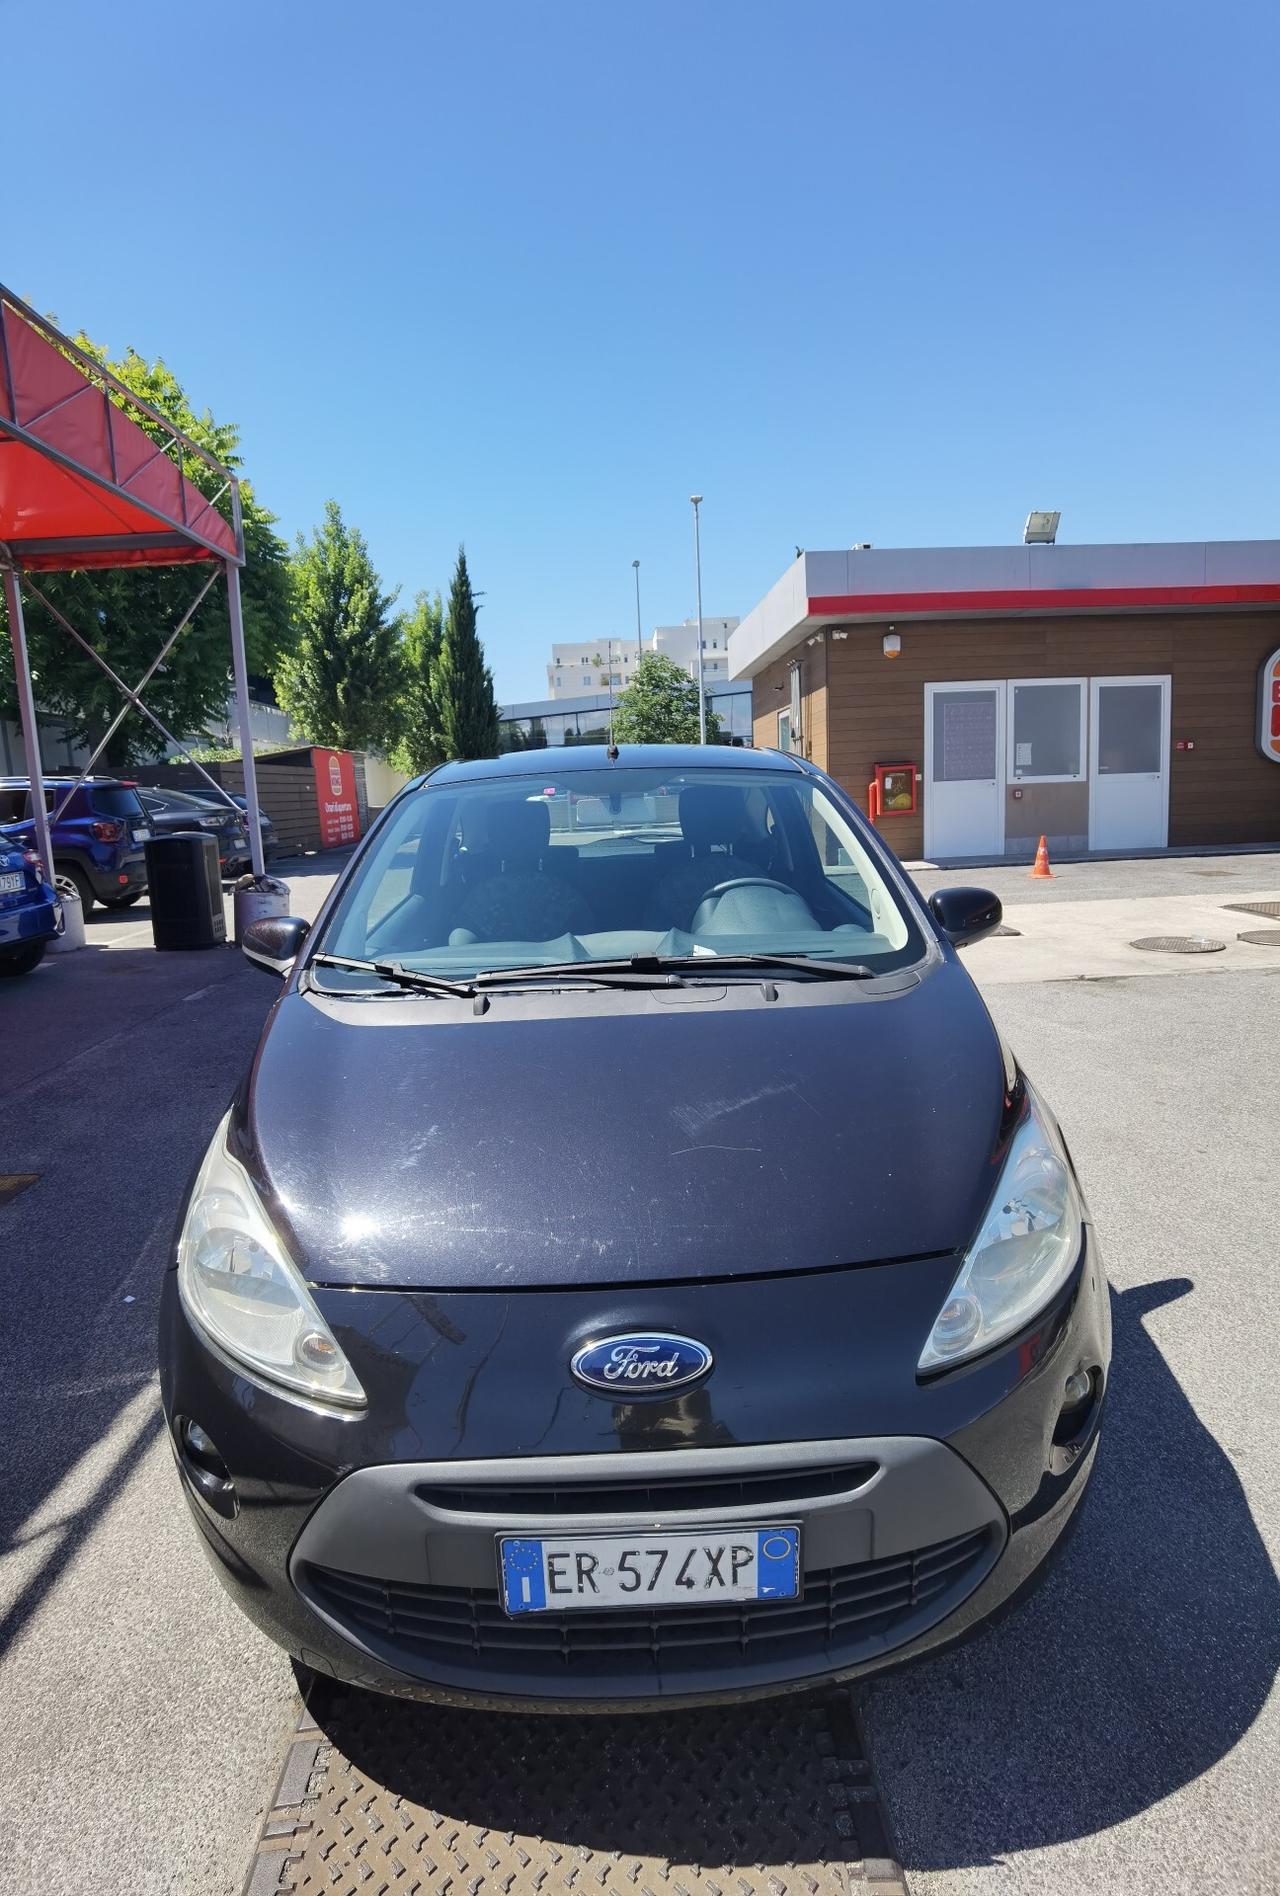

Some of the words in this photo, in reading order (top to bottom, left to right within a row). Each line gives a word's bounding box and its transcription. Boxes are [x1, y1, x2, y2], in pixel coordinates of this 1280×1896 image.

[603, 1345, 680, 1380] Ford
[547, 1552, 600, 1594] ER
[617, 1545, 754, 1593] 574XP
